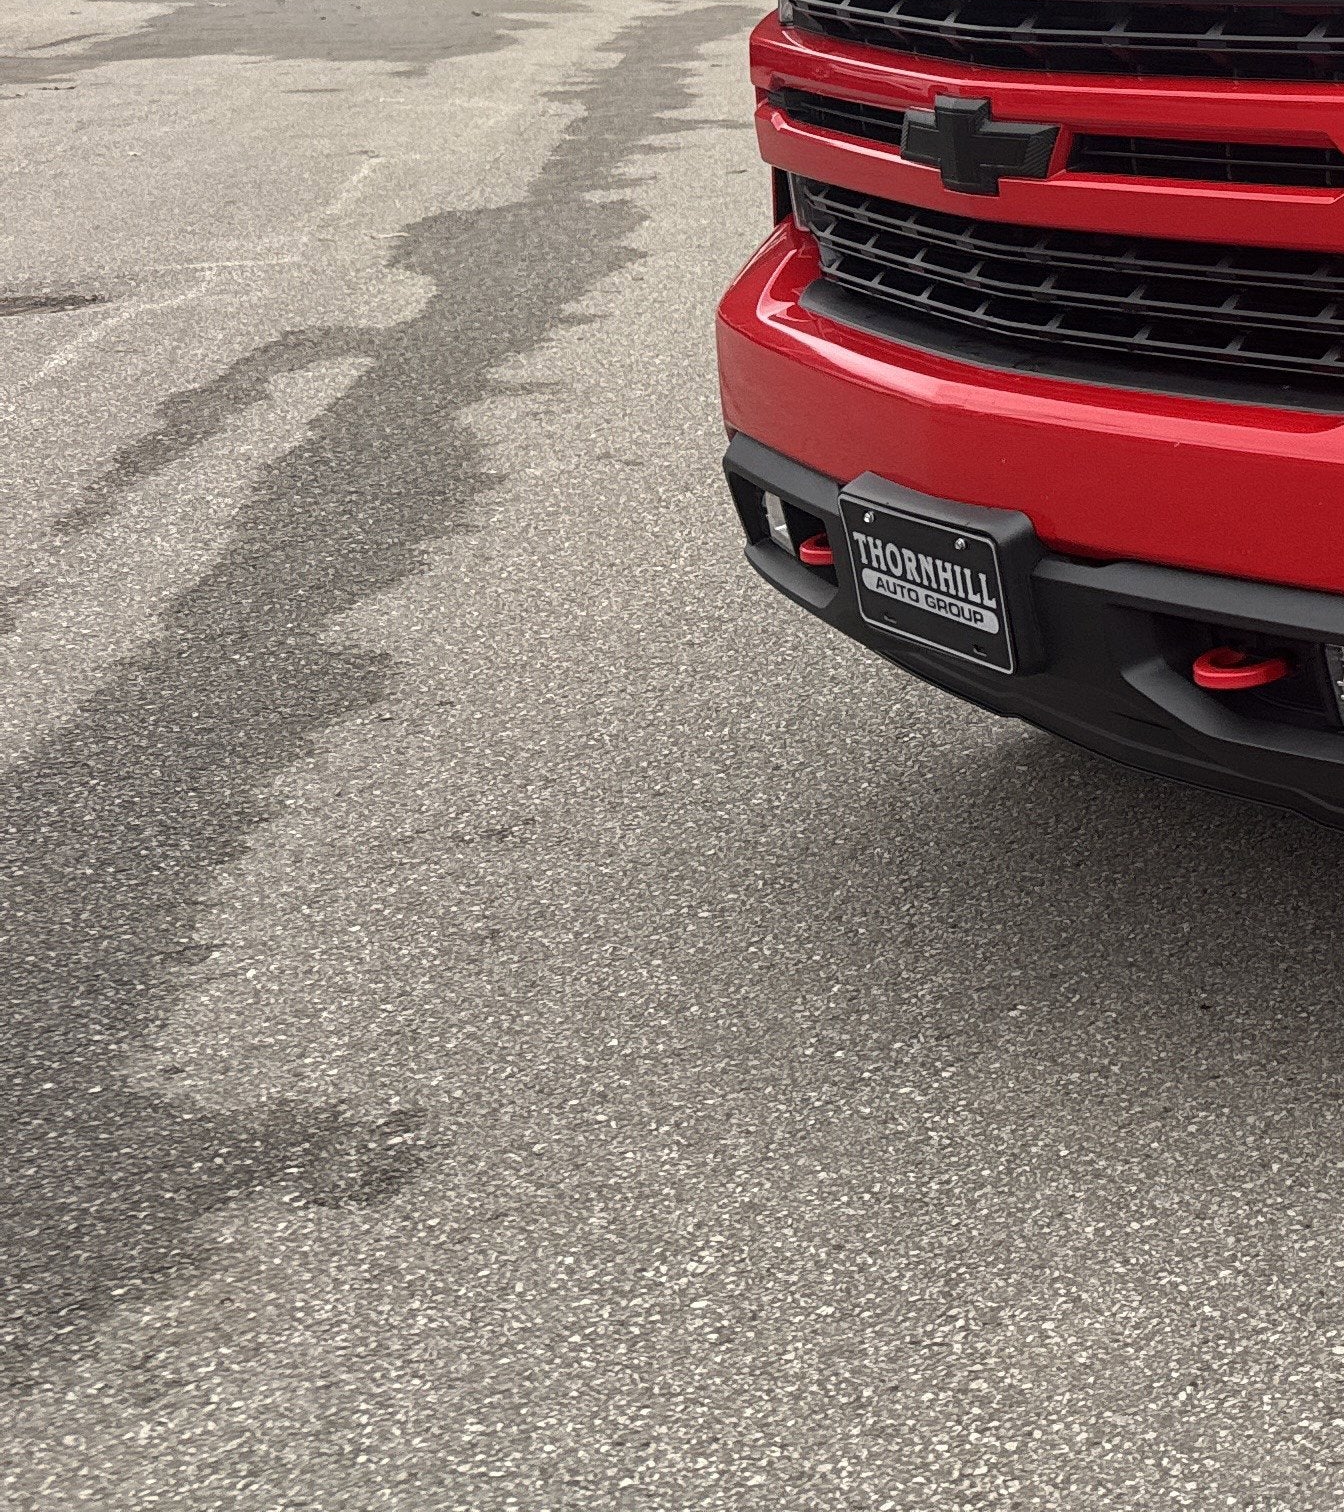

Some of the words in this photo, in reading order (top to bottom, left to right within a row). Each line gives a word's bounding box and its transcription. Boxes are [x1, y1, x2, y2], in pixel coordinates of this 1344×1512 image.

[852, 531, 997, 609] THORNHILL
[876, 576, 920, 603] AUTO
[925, 595, 984, 625] GROUP
